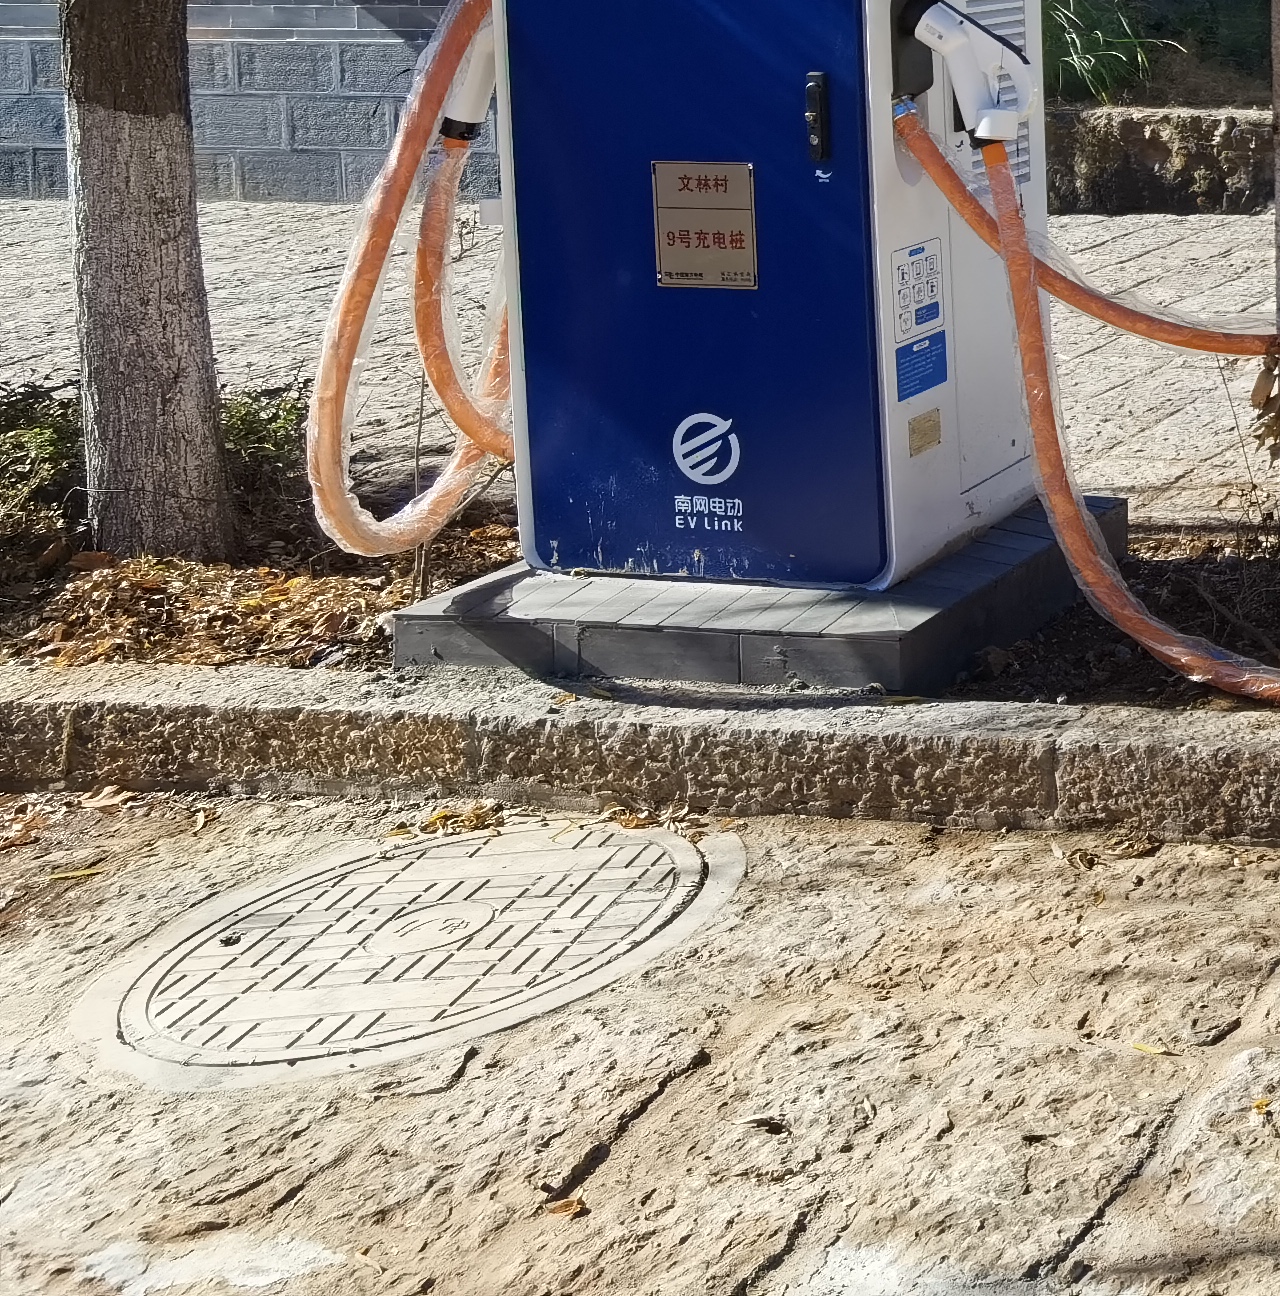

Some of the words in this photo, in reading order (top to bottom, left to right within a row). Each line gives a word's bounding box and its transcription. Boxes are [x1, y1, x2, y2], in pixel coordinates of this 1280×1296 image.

[678, 174, 729, 194] 文林村
[666, 229, 746, 250] 9号充电桩
[674, 494, 743, 517] 南网电动
[675, 515, 697, 529] EV
[704, 517, 743, 532] Link
